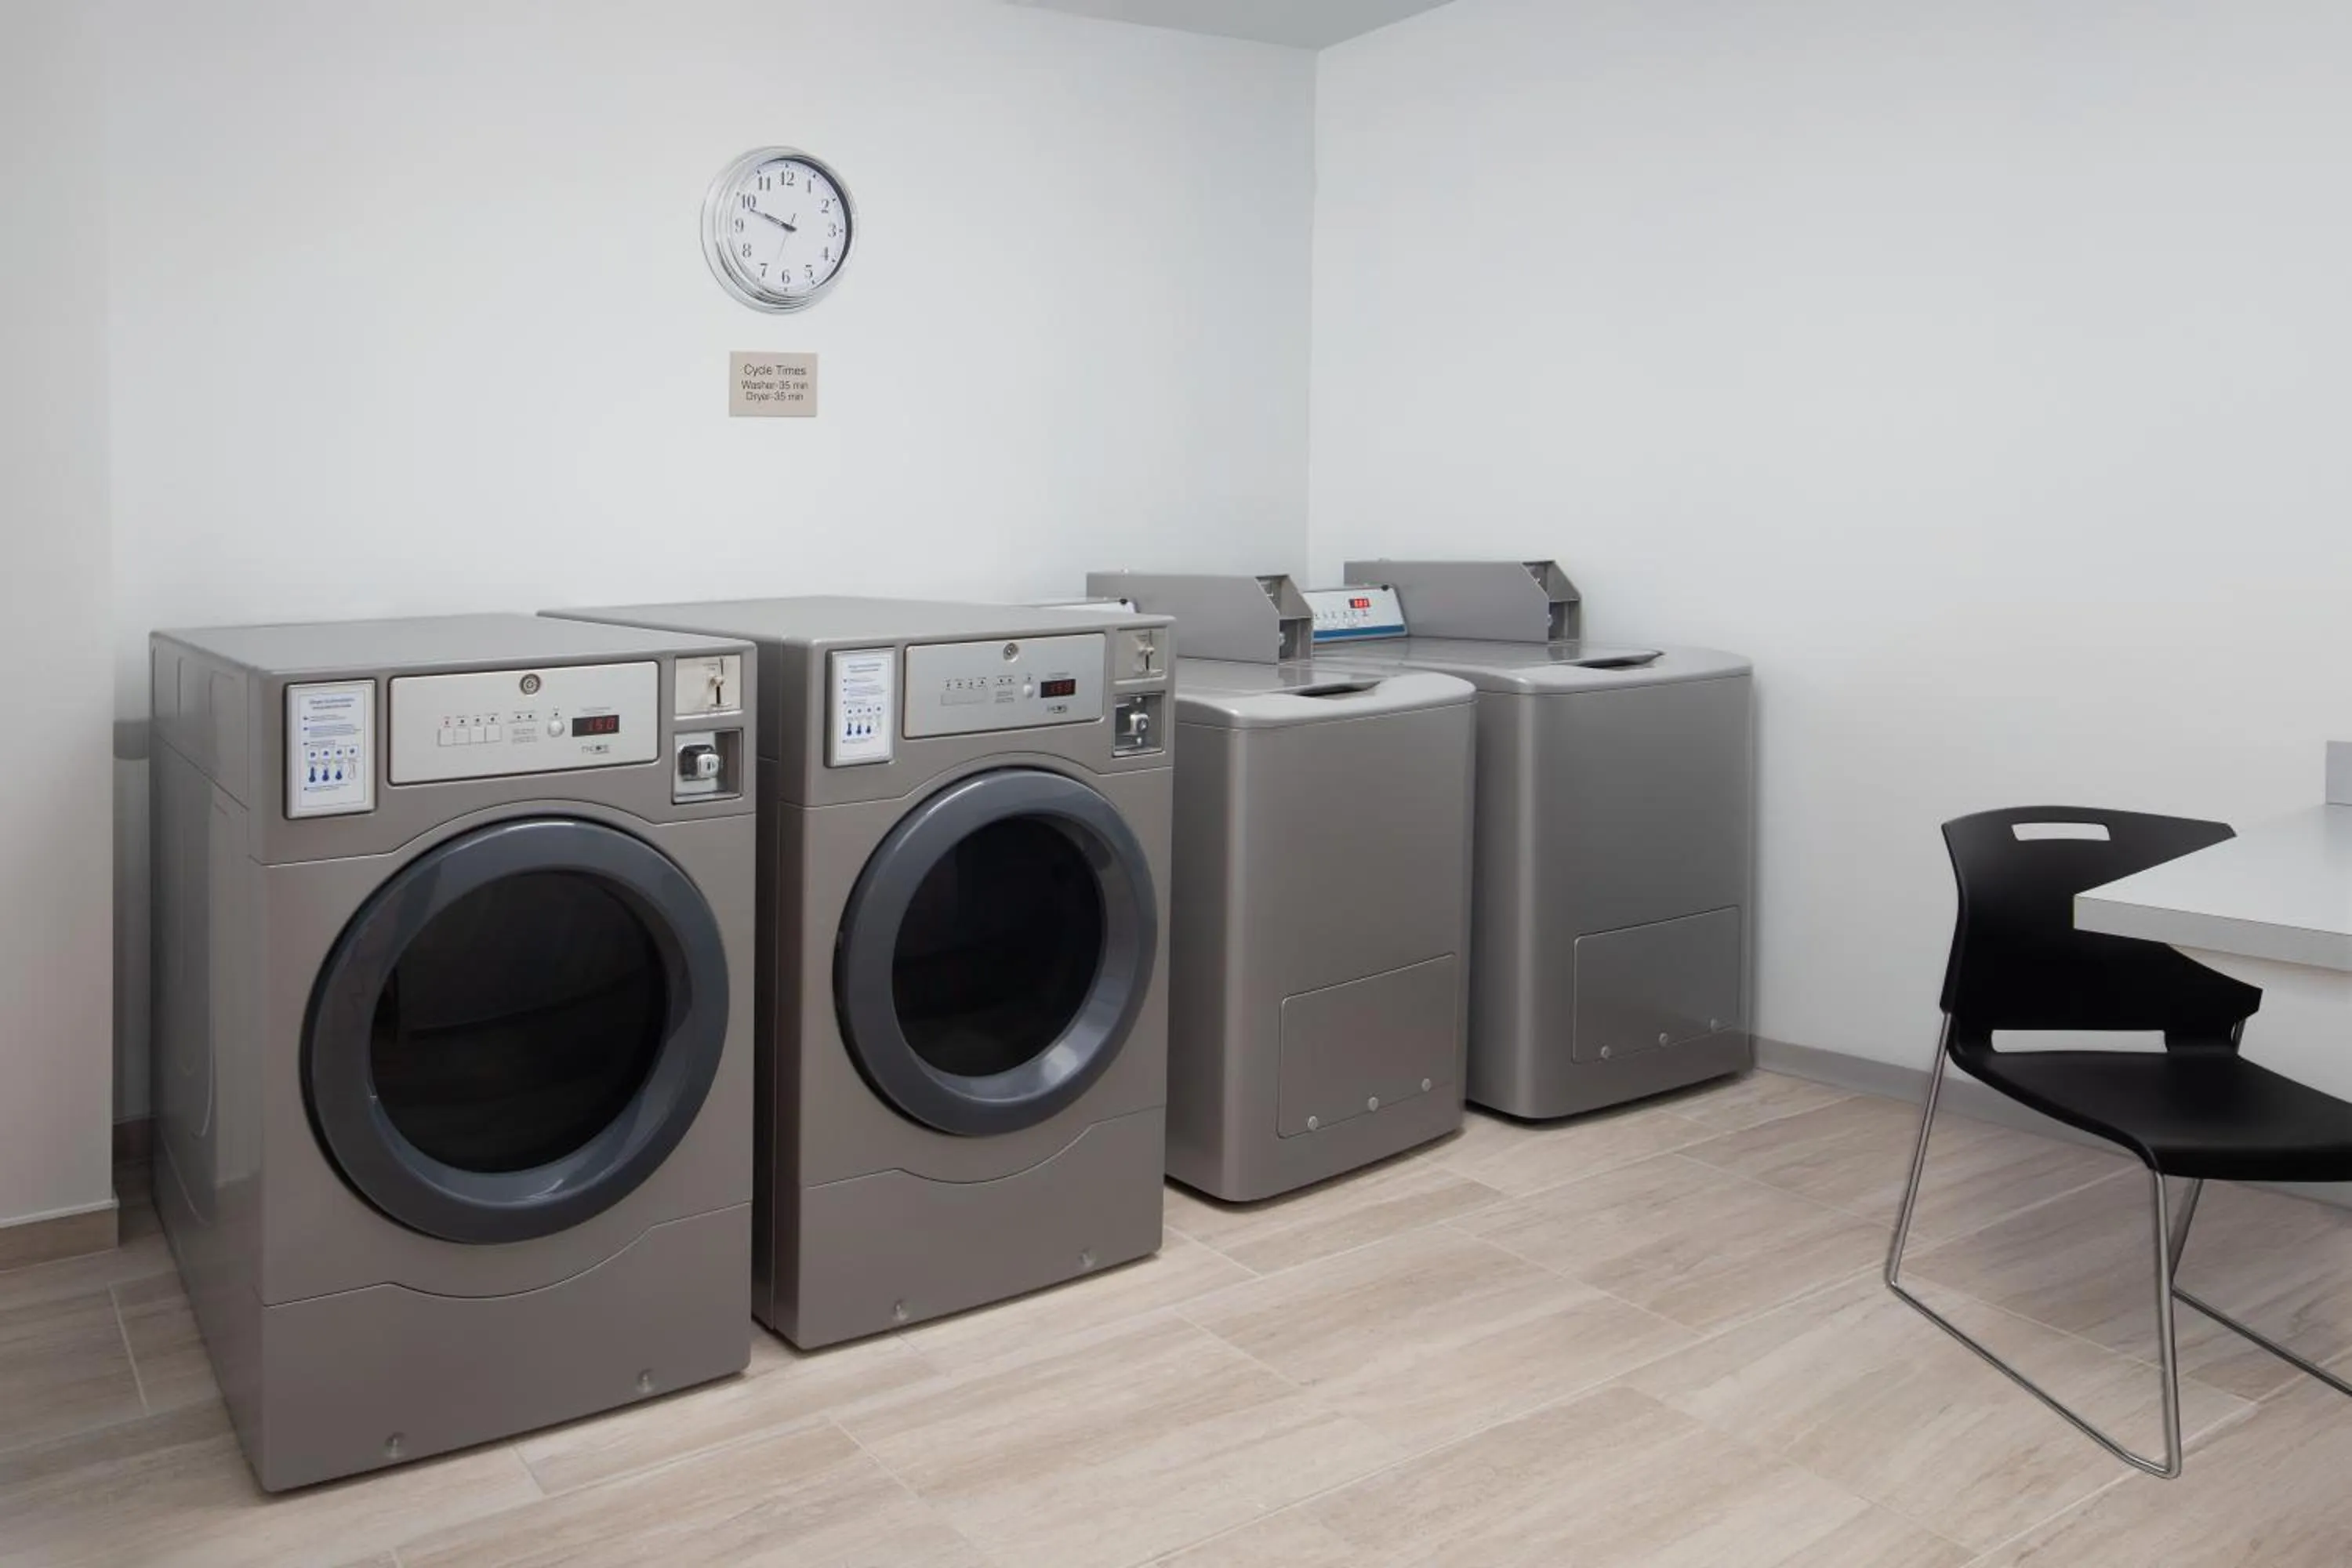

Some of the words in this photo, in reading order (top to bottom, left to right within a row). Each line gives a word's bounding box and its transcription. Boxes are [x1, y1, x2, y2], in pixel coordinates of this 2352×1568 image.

[758, 176, 771, 191] 11
[780, 171, 795, 187] 12
[807, 179, 811, 194] 1
[742, 194, 757, 209] 10
[821, 199, 829, 214] 2
[735, 217, 744, 234] 9
[828, 223, 837, 238] 3
[742, 243, 752, 258] 8
[820, 246, 829, 261] 4
[760, 263, 768, 277] 7
[782, 269, 791, 285] 6
[804, 264, 814, 279] 5
[743, 363, 772, 376] Cycle
[775, 365, 806, 375] Times
